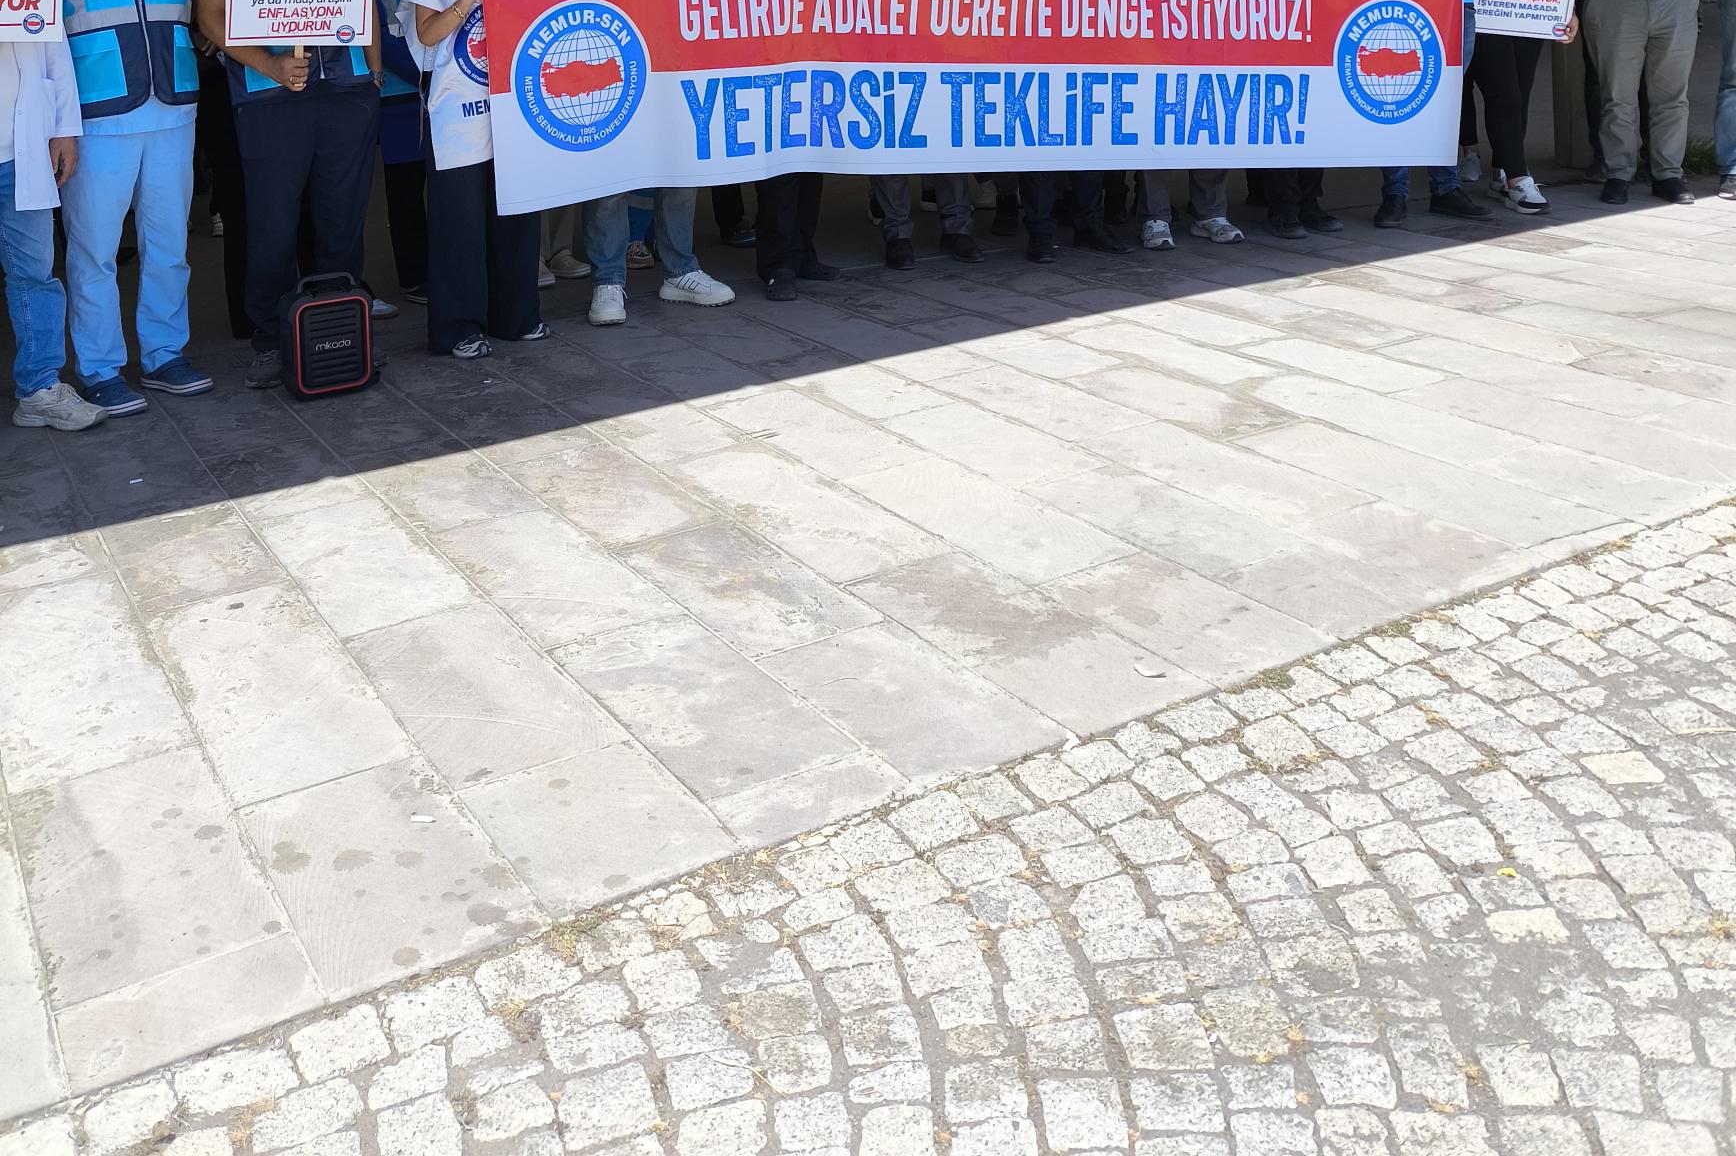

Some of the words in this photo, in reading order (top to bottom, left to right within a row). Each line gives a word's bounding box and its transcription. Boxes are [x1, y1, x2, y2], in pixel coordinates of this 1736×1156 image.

[258, 6, 343, 19] ENFLASYONA
[1348, 6, 1432, 42] MEMUR-SEN
[1477, 8, 1512, 18] EREĞİNİ
[1514, 12, 1562, 22] YAPMIYOR!
[1519, 3, 1558, 12] MASADA
[271, 20, 332, 33] UYDURUN
[528, 9, 632, 59] MEMUR-SEN
[1344, 54, 1354, 89] MEMUR
[524, 76, 541, 116] MEMUR
[594, 60, 637, 141] KONFEDERASYONU
[1154, 72, 1310, 146] HAYIR!
